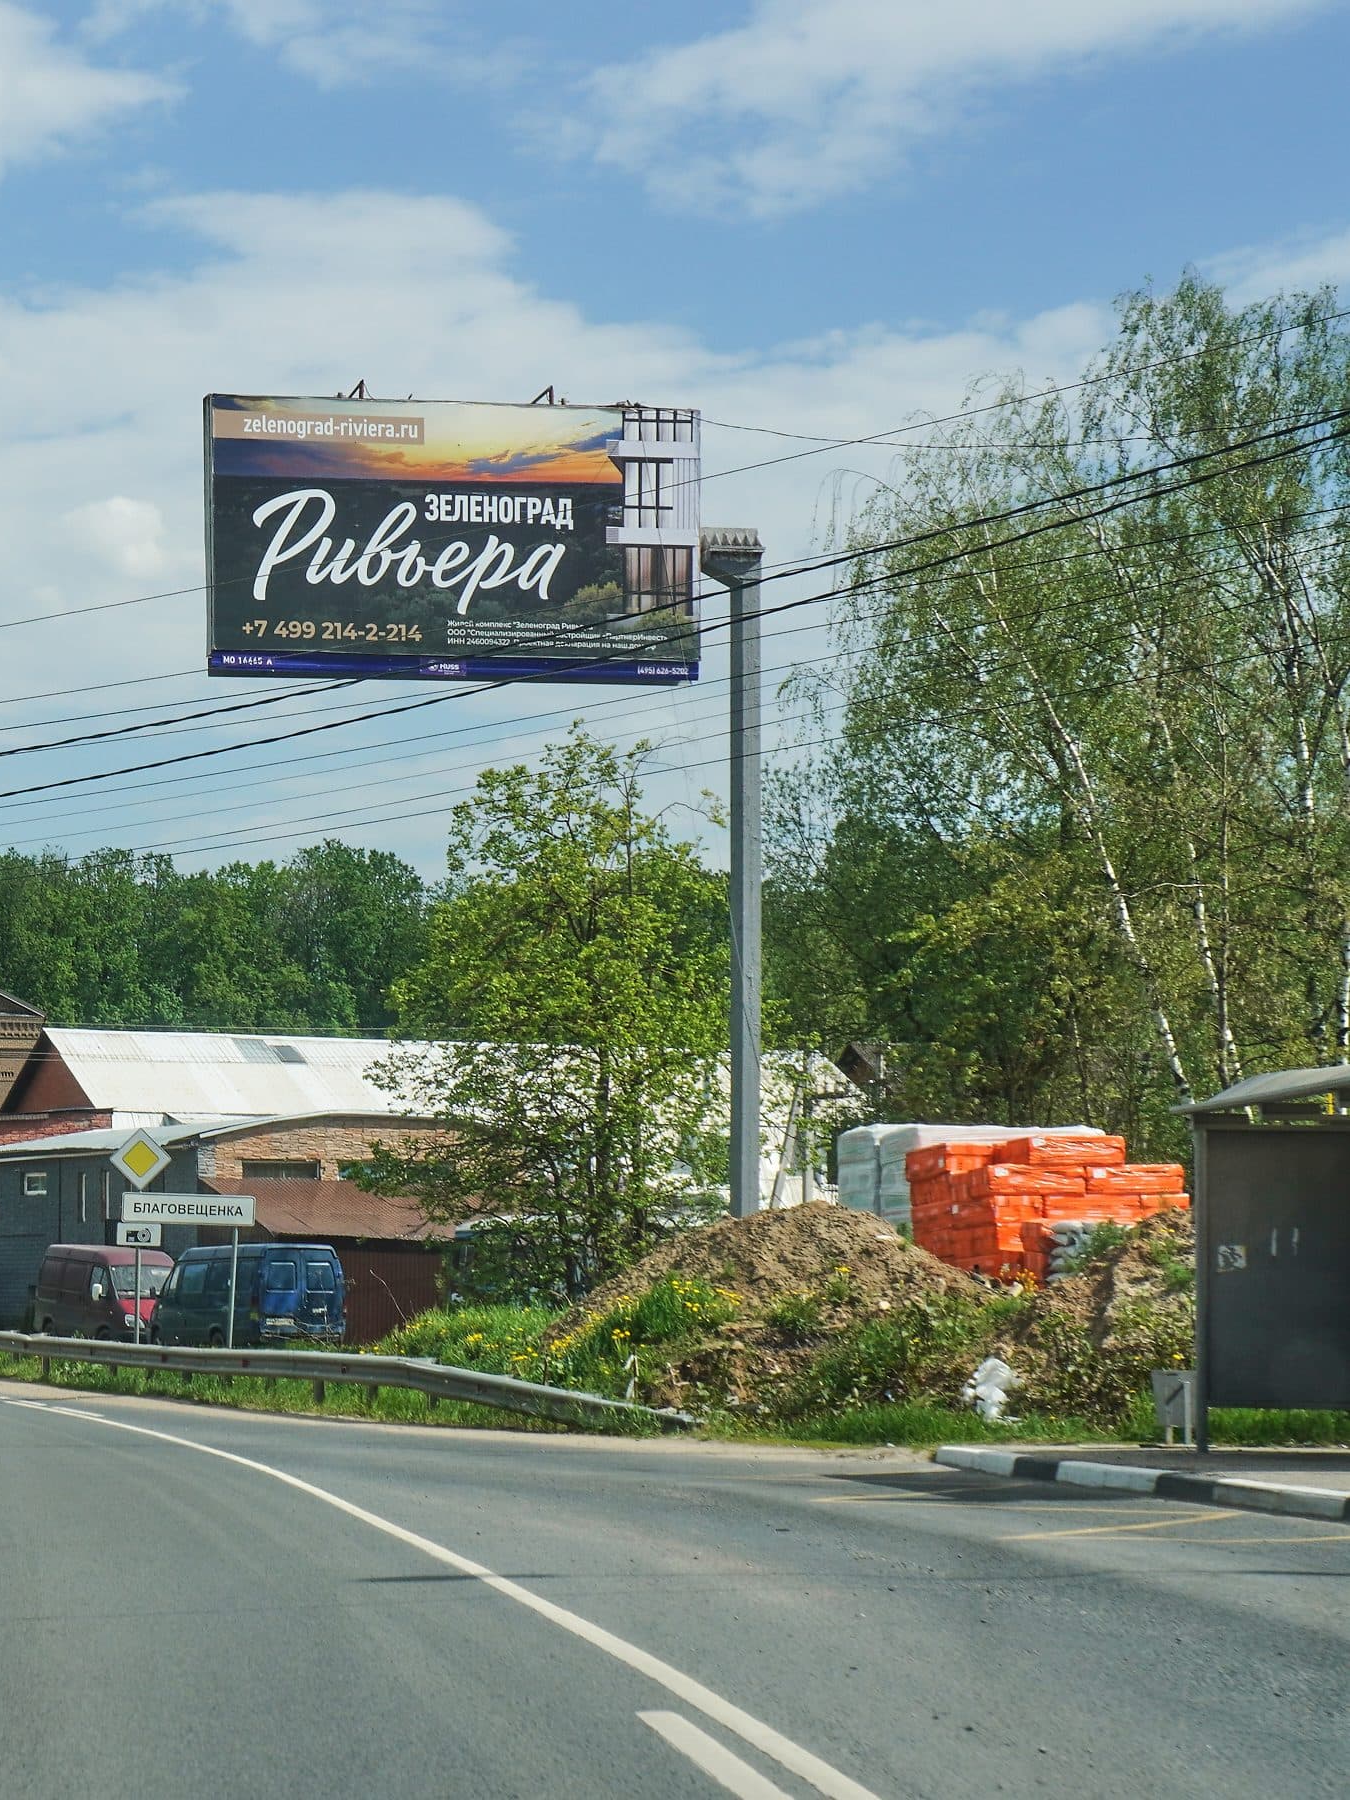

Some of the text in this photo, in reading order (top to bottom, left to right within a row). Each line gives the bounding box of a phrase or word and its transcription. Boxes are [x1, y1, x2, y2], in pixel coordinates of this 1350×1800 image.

[243, 415, 418, 438] zelenograd-riviera.ru
[424, 493, 574, 530] ЗЕЛЕНОГРАД
[252, 488, 566, 615] Ривьера
[242, 619, 423, 642] +7 499 214-2-214
[133, 1202, 243, 1217] БЛАГОВЕЩЕНКА
